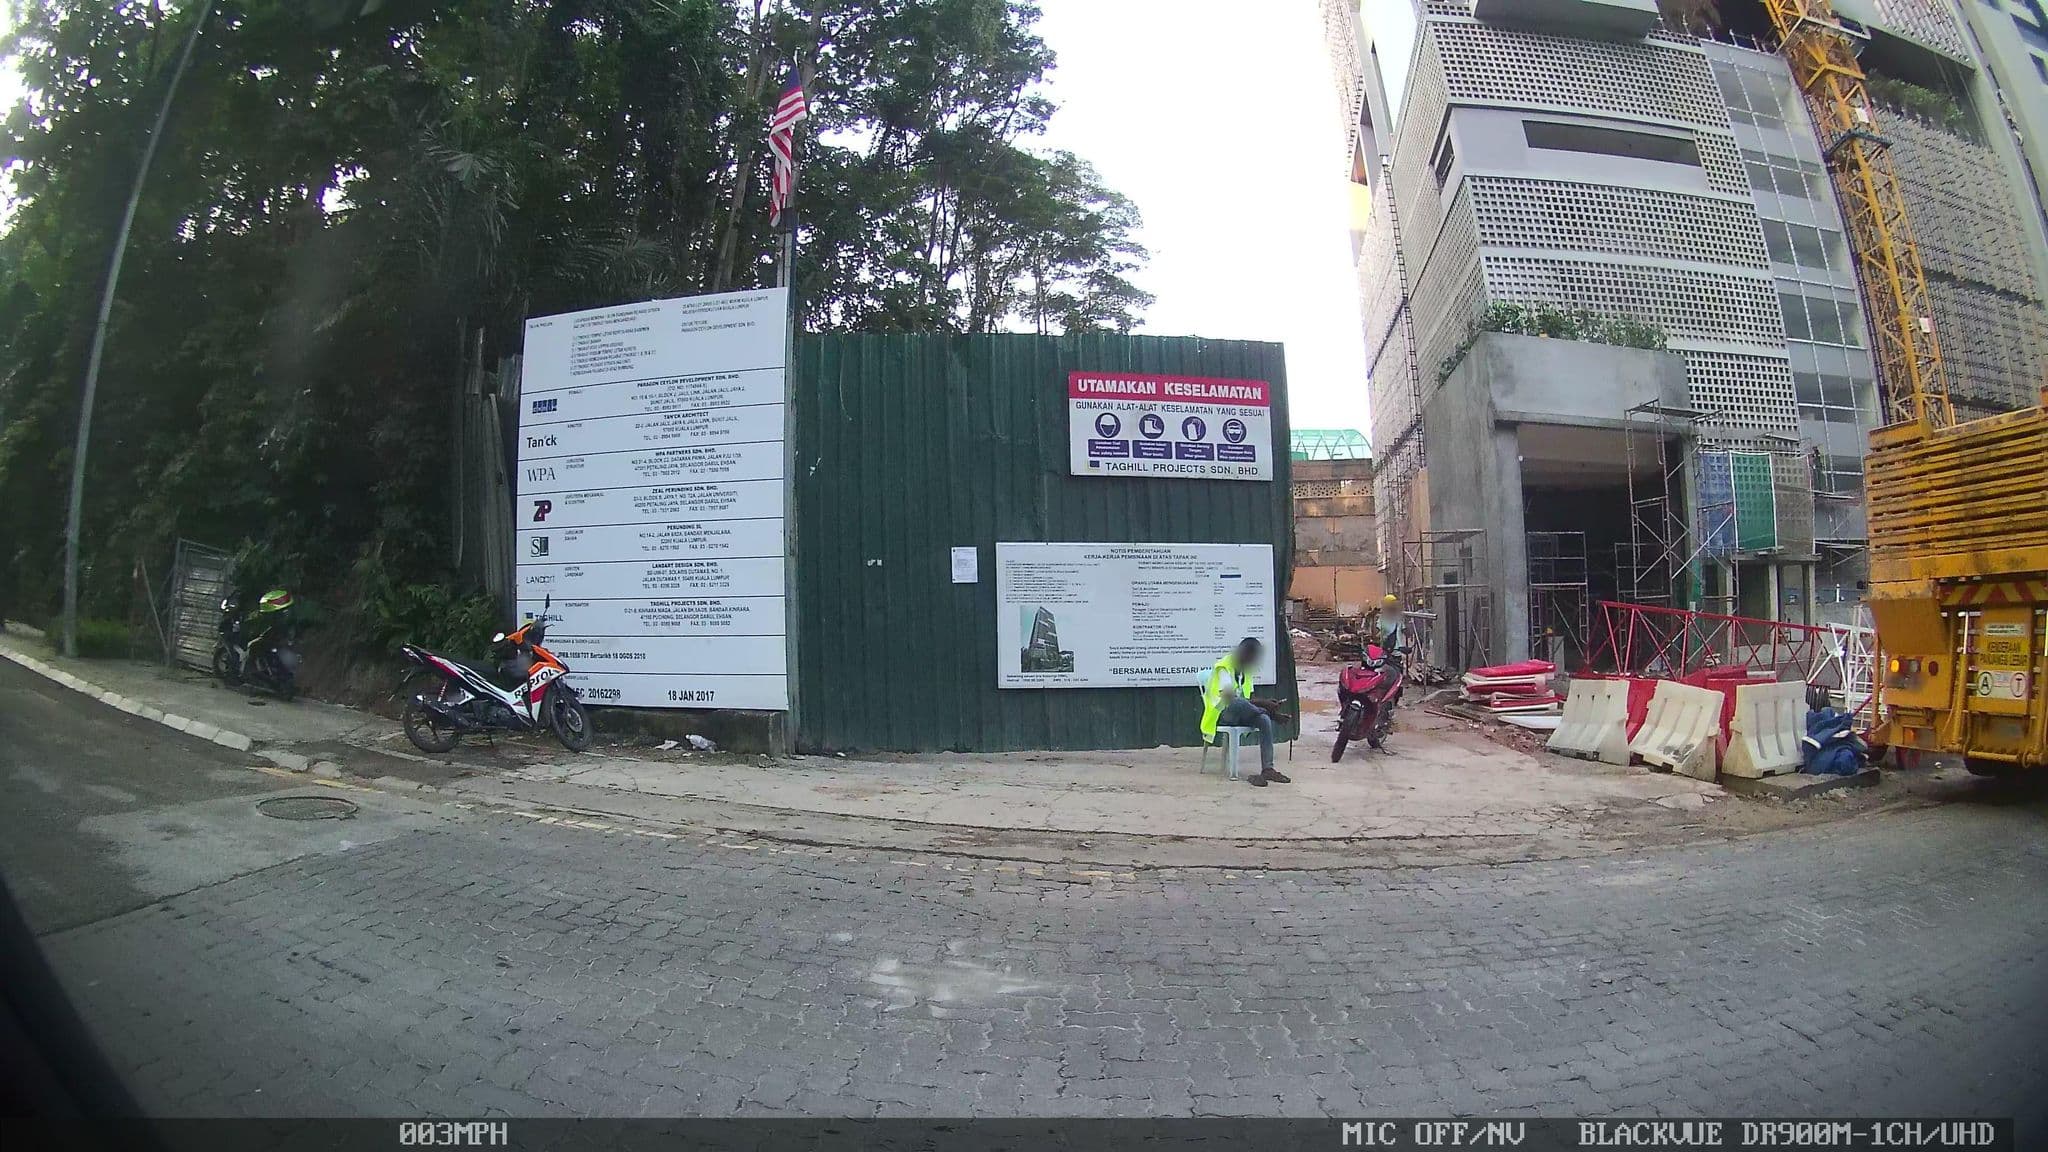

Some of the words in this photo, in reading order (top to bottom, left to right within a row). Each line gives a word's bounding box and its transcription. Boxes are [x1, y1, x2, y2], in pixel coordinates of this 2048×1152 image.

[1078, 379, 1156, 394] UTAMAKAN
[1164, 382, 1261, 400] KESELAMATAN
[1076, 402, 1113, 410] GUNAKAN
[1116, 402, 1158, 412] ALAT-ALAT
[1161, 404, 1213, 414] KESELAMATAN
[1216, 408, 1236, 416] YANG
[1239, 409, 1265, 418] SESUAI
[527, 467, 556, 482] WPA
[1106, 462, 1148, 472] TAGHILL
[1153, 464, 1206, 474] PROJECTS
[1211, 466, 1234, 474] SDN.
[514, 669, 554, 699] REPSOL
[1980, 676, 1990, 690] A
[588, 688, 621, 698] 20162298
[668, 690, 677, 700] 18
[679, 690, 694, 700] JAN
[696, 690, 714, 702] 2017
